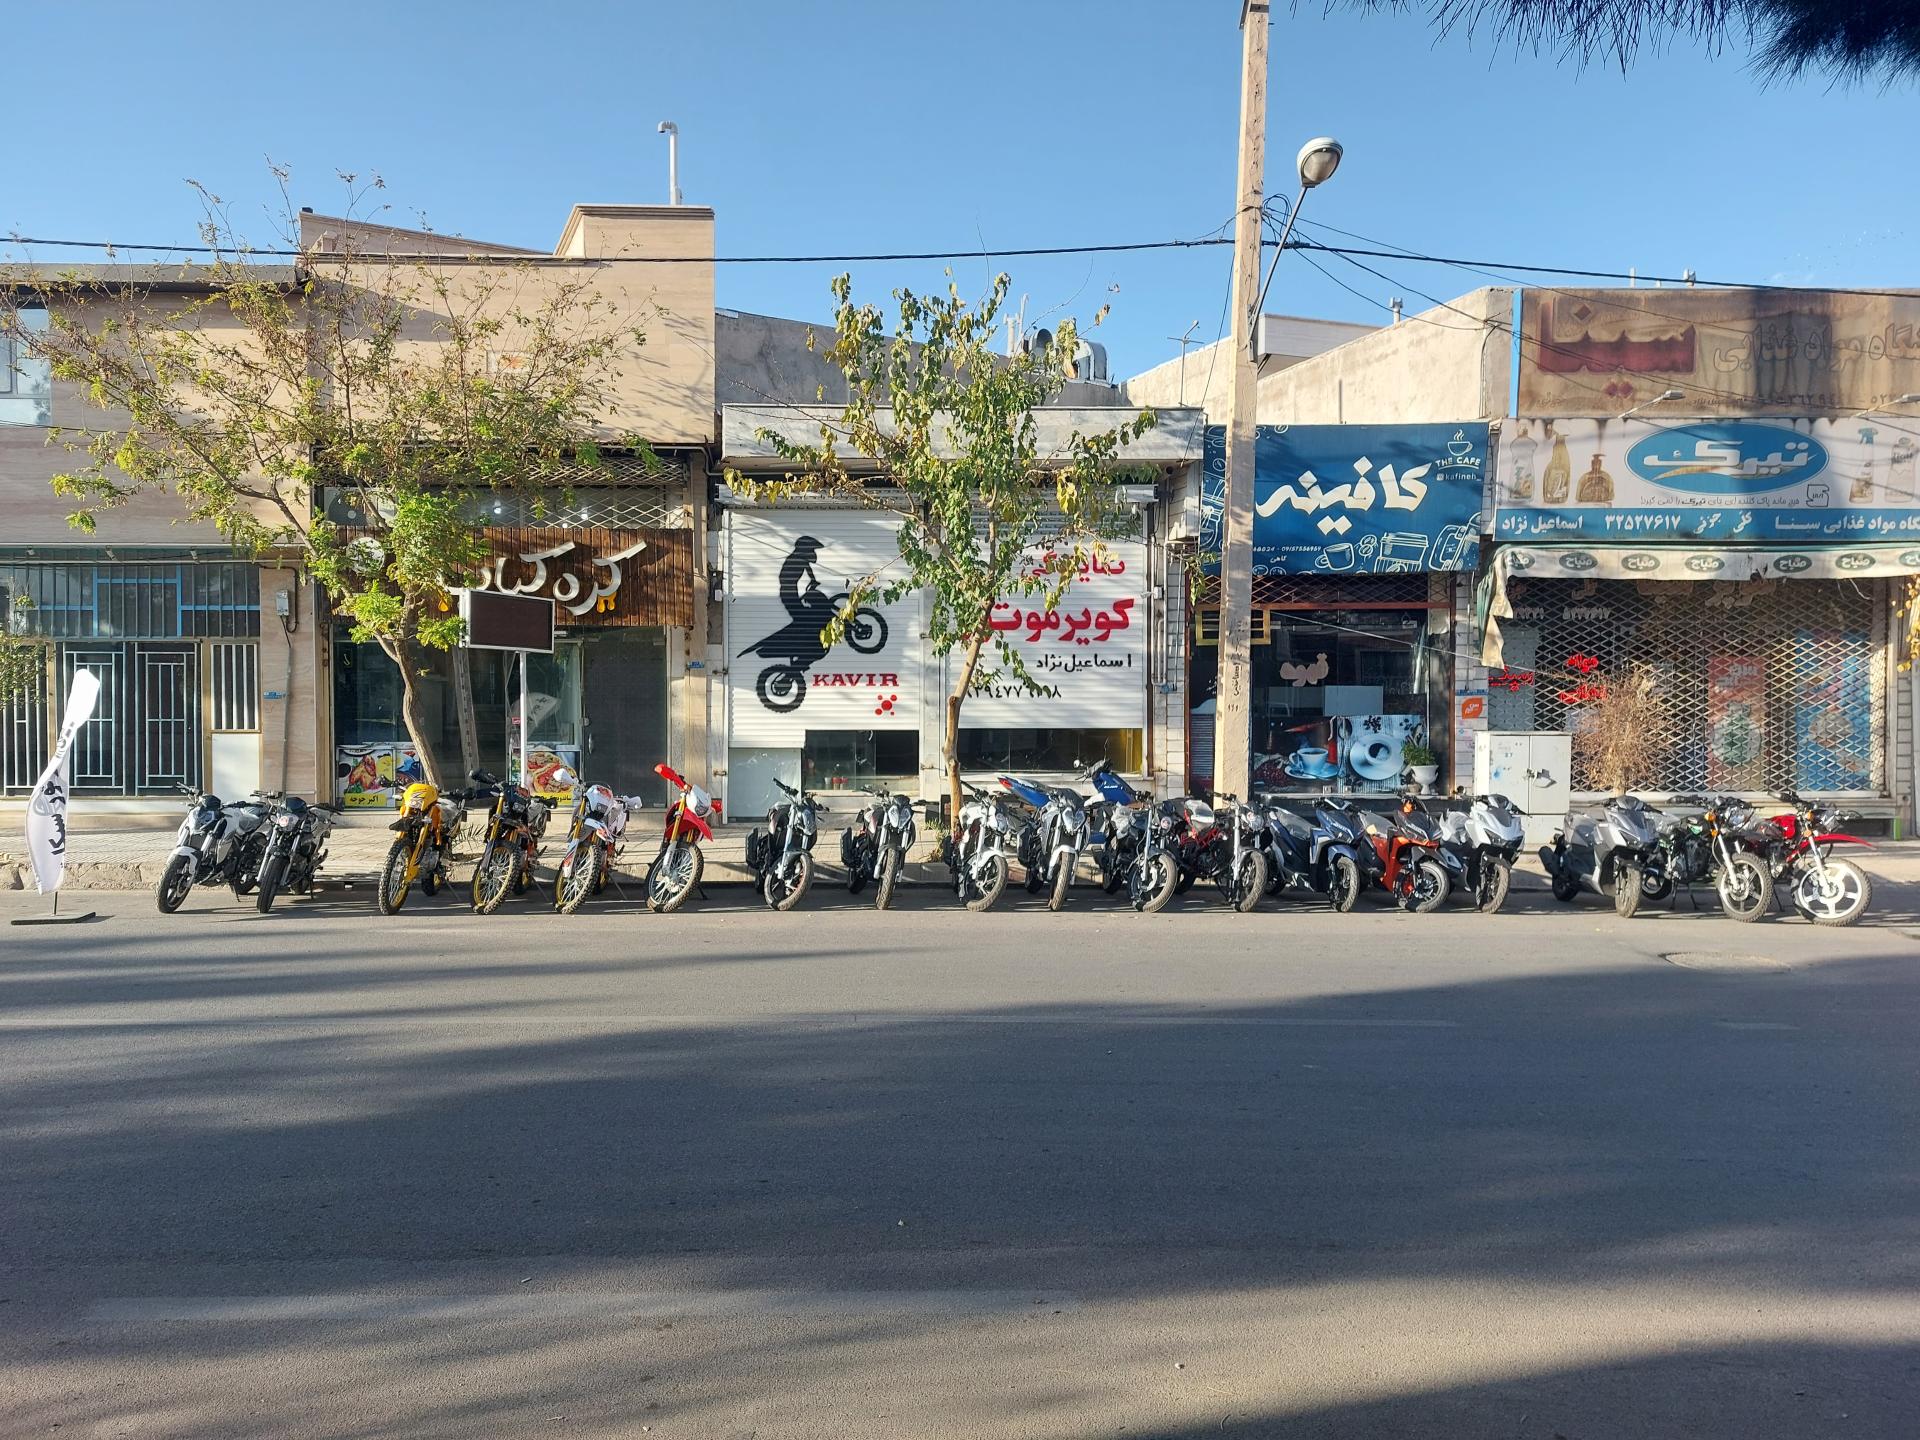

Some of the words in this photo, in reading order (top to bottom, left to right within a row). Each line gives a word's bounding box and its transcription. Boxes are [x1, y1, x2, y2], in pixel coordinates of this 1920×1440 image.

[1435, 457, 1453, 467] THE
[1456, 456, 1481, 466] CAFE
[1255, 455, 1433, 536] کافینه
[1502, 514, 1529, 535] نژاد
[1530, 514, 1584, 535] اسماعیل
[1774, 515, 1820, 530] سینا
[1823, 515, 1865, 535] غذایی
[1868, 515, 1896, 535] مواد
[552, 539, 648, 616] کره
[1036, 653, 1063, 673] نژاد
[1064, 653, 1132, 673] اسماعیل
[812, 673, 900, 687] KAVIR
